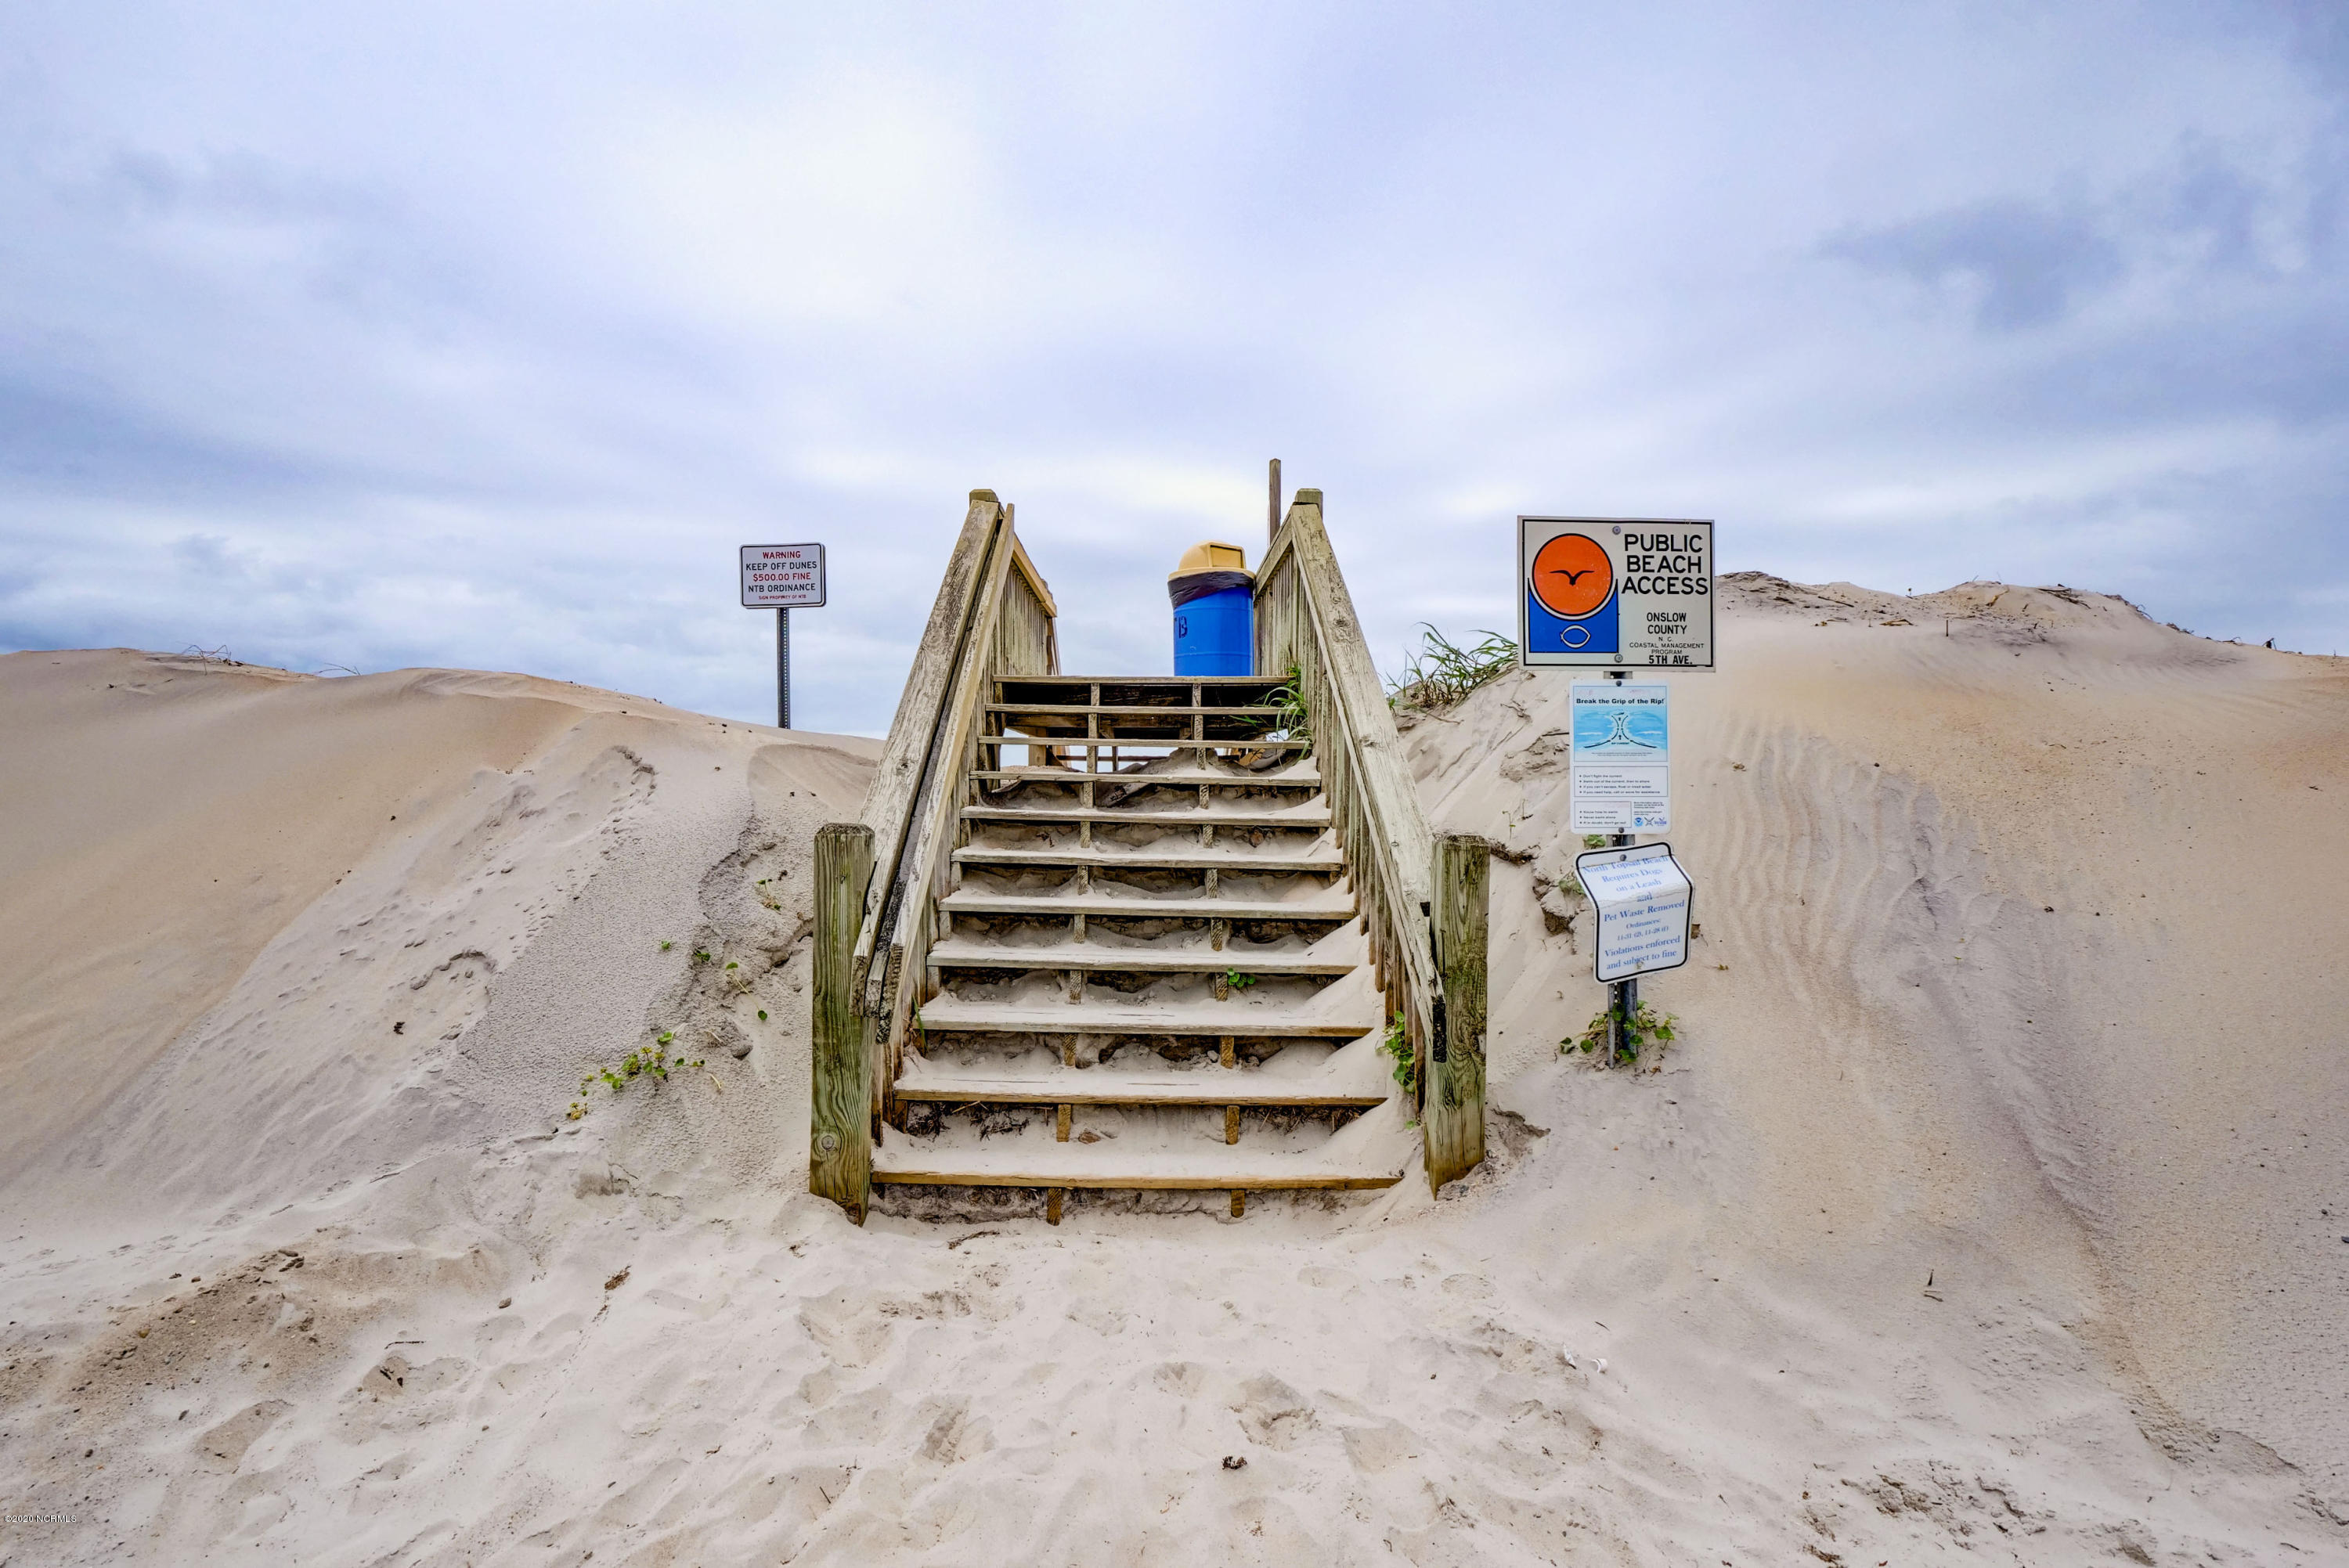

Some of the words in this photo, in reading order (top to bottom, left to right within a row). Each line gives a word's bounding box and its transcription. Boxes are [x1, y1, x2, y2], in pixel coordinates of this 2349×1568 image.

[1624, 534, 1703, 553] PUBLIC
[762, 550, 801, 559] WARNING
[770, 562, 787, 571] OFF
[789, 561, 817, 570] DUNES
[1626, 555, 1701, 574] BEACH
[752, 573, 790, 582] $500.00
[767, 583, 816, 593] ORDINANCE
[1622, 576, 1709, 595] ACCESS
[1647, 612, 1687, 622] ONSLOW
[1647, 625, 1687, 635] COUNTY
[1649, 655, 1668, 665] 5TH
[1672, 655, 1693, 665] AVE.
[1583, 864, 1607, 874] North
[1611, 859, 1640, 870] Topsail
[1643, 855, 1669, 864] Beach
[1602, 870, 1640, 883] Requires
[1640, 868, 1662, 878] Dogs
[1616, 885, 1628, 893] on
[1636, 879, 1662, 889] Leash
[1637, 892, 1654, 903] and
[1604, 912, 1617, 922] Pet
[1620, 909, 1644, 919] Waste
[1647, 899, 1685, 914] Removed
[1604, 944, 1644, 957] Violations
[1646, 935, 1681, 949] enforced
[1607, 961, 1621, 970] and
[1623, 954, 1650, 965] subject
[1651, 950, 1660, 960] to
[1662, 949, 1677, 959] fine
